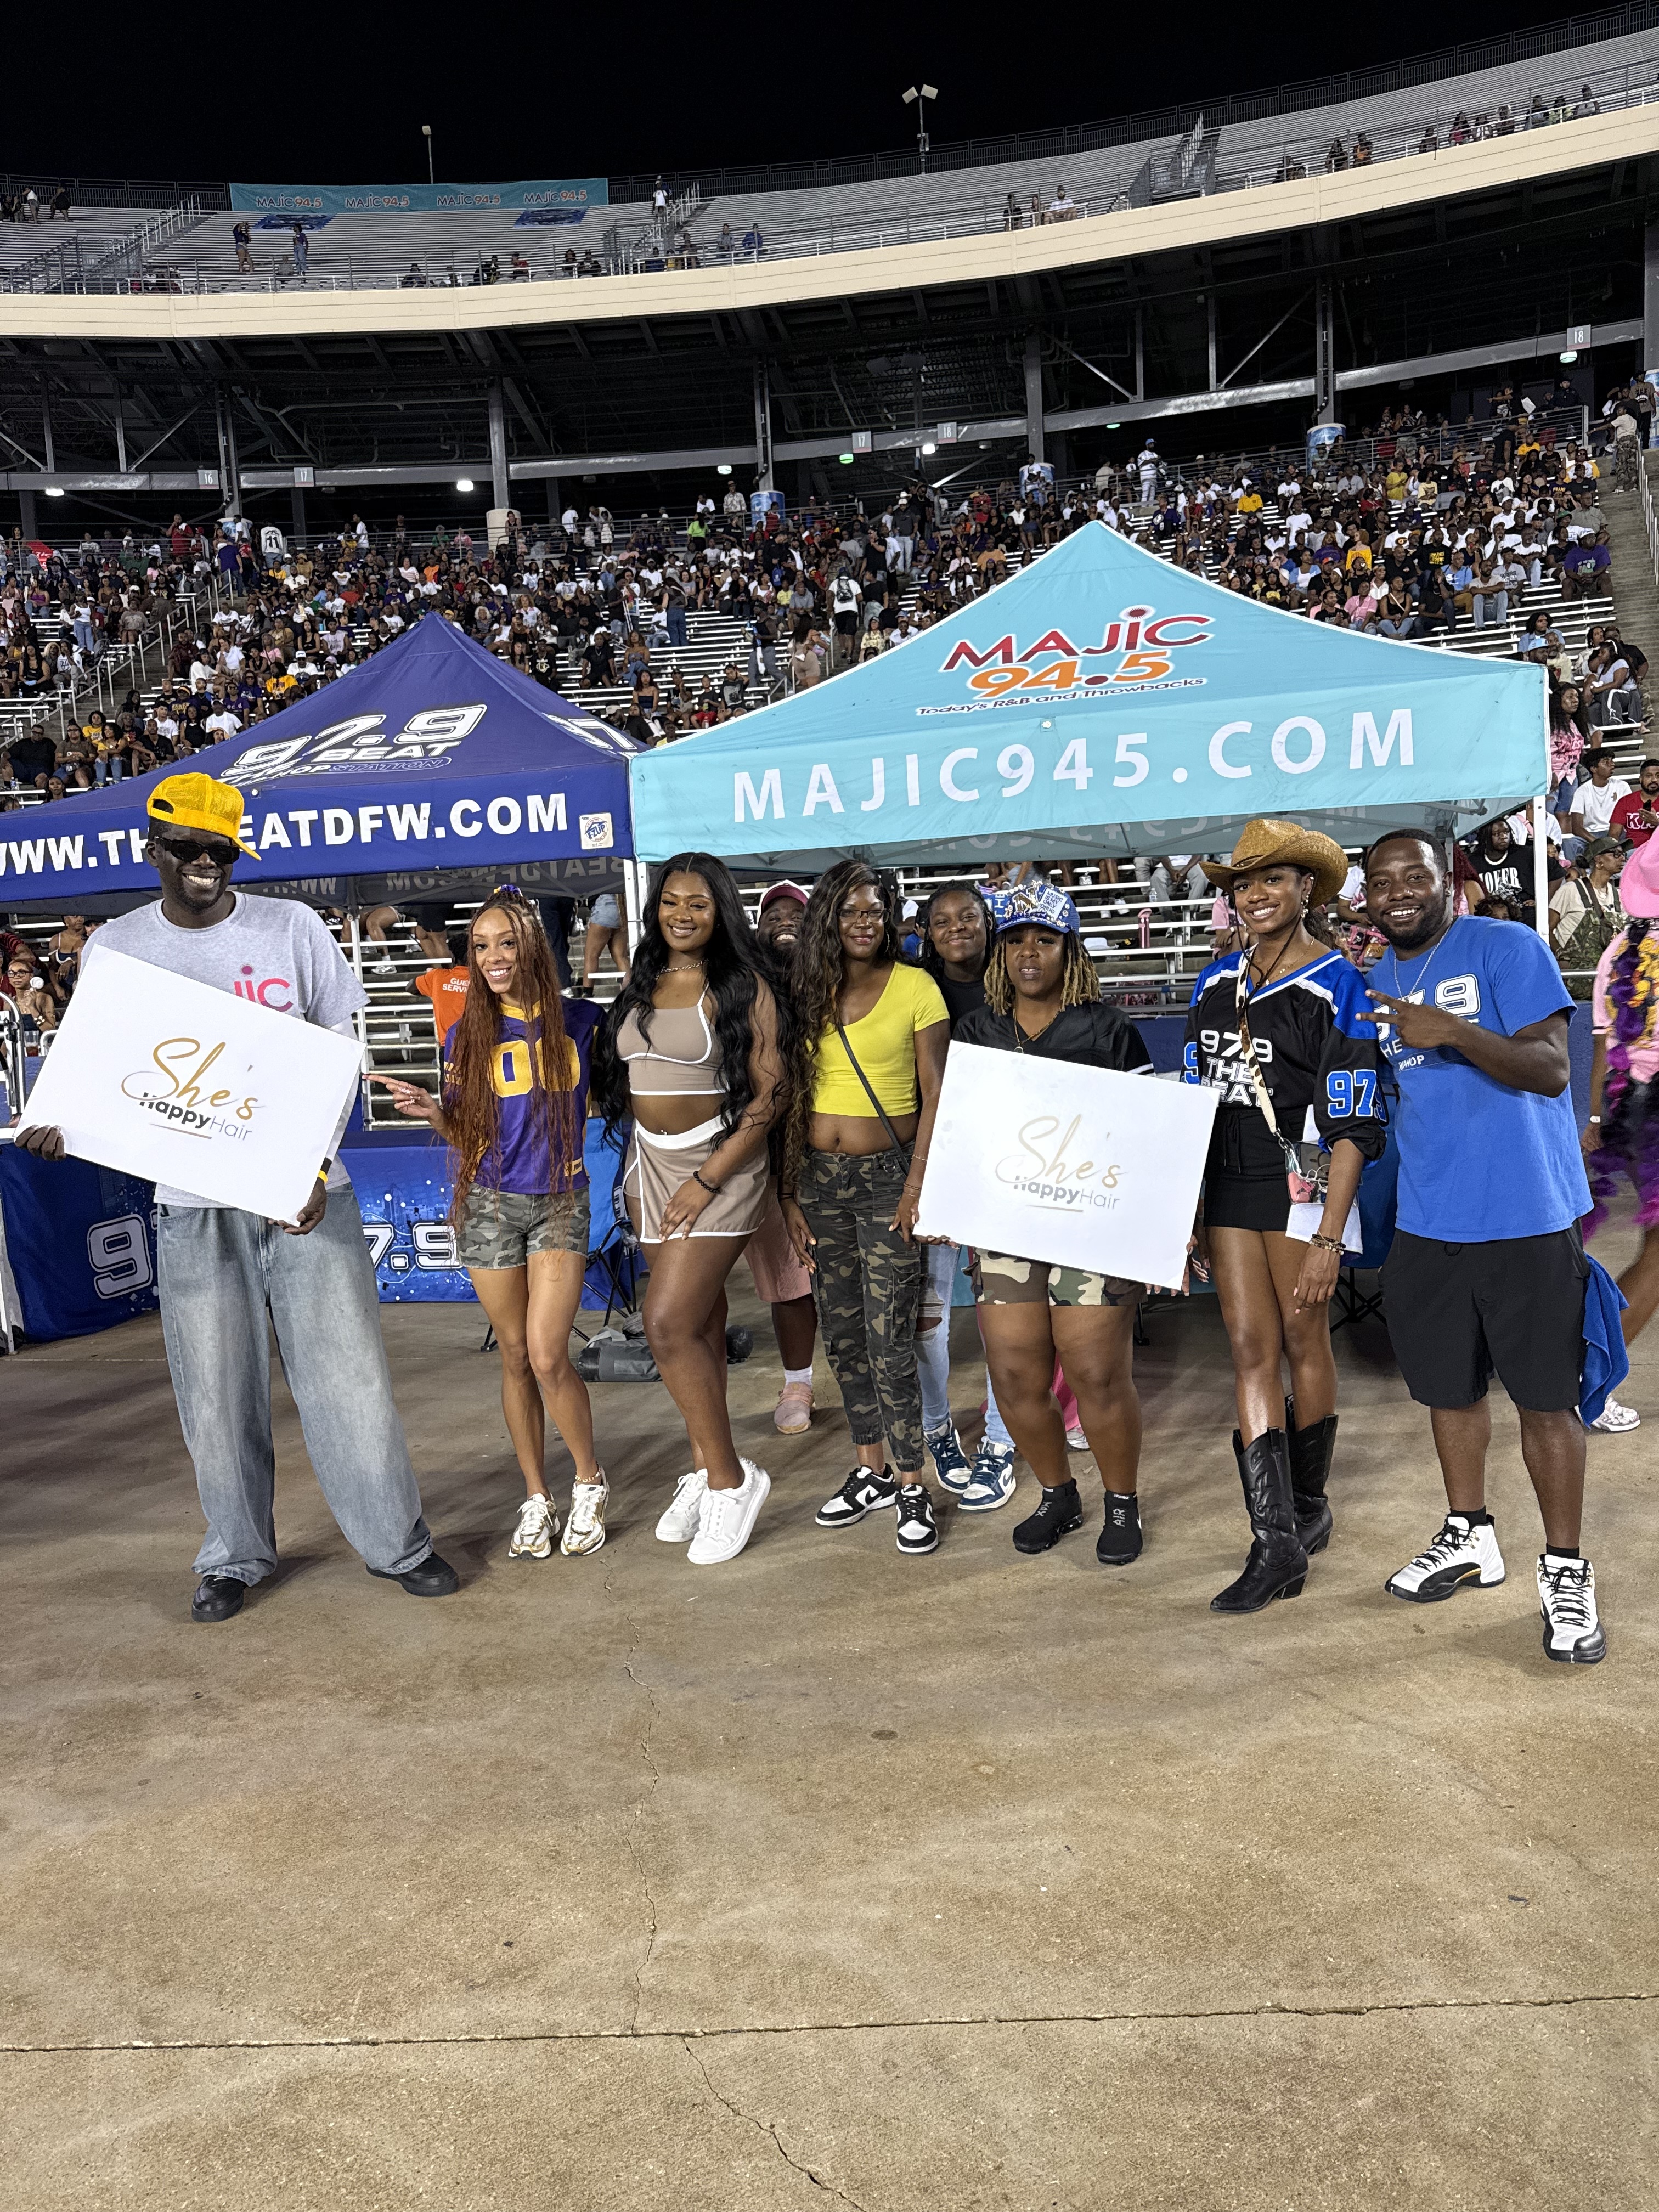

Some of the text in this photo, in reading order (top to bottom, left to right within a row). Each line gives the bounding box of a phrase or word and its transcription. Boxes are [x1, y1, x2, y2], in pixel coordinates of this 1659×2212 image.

[257, 194, 323, 207] MAJIC 94.5
[346, 194, 410, 208] MAJIC 94.5
[437, 193, 500, 205] MAJIC 94.5
[525, 189, 587, 202] MAJIC 94.5
[1574, 330, 1584, 343] 18
[943, 426, 952, 438] 18
[858, 436, 865, 447] 17
[204, 473, 213, 484] 16
[301, 471, 308, 482] 17
[266, 535, 280, 549] 11
[942, 607, 1214, 670] MAJIC
[970, 651, 1170, 698] 94.5
[919, 677, 1204, 715] Today's R&B and Throwbacks
[221, 704, 487, 777] 97.9
[311, 741, 462, 763] BEAT
[734, 708, 1415, 822] MAJIC945.COM
[1206, 1056, 1254, 1083] THE
[121, 1037, 266, 1120] She's
[995, 1113, 1129, 1189] She's
[1113, 1508, 1126, 1527] AIR
